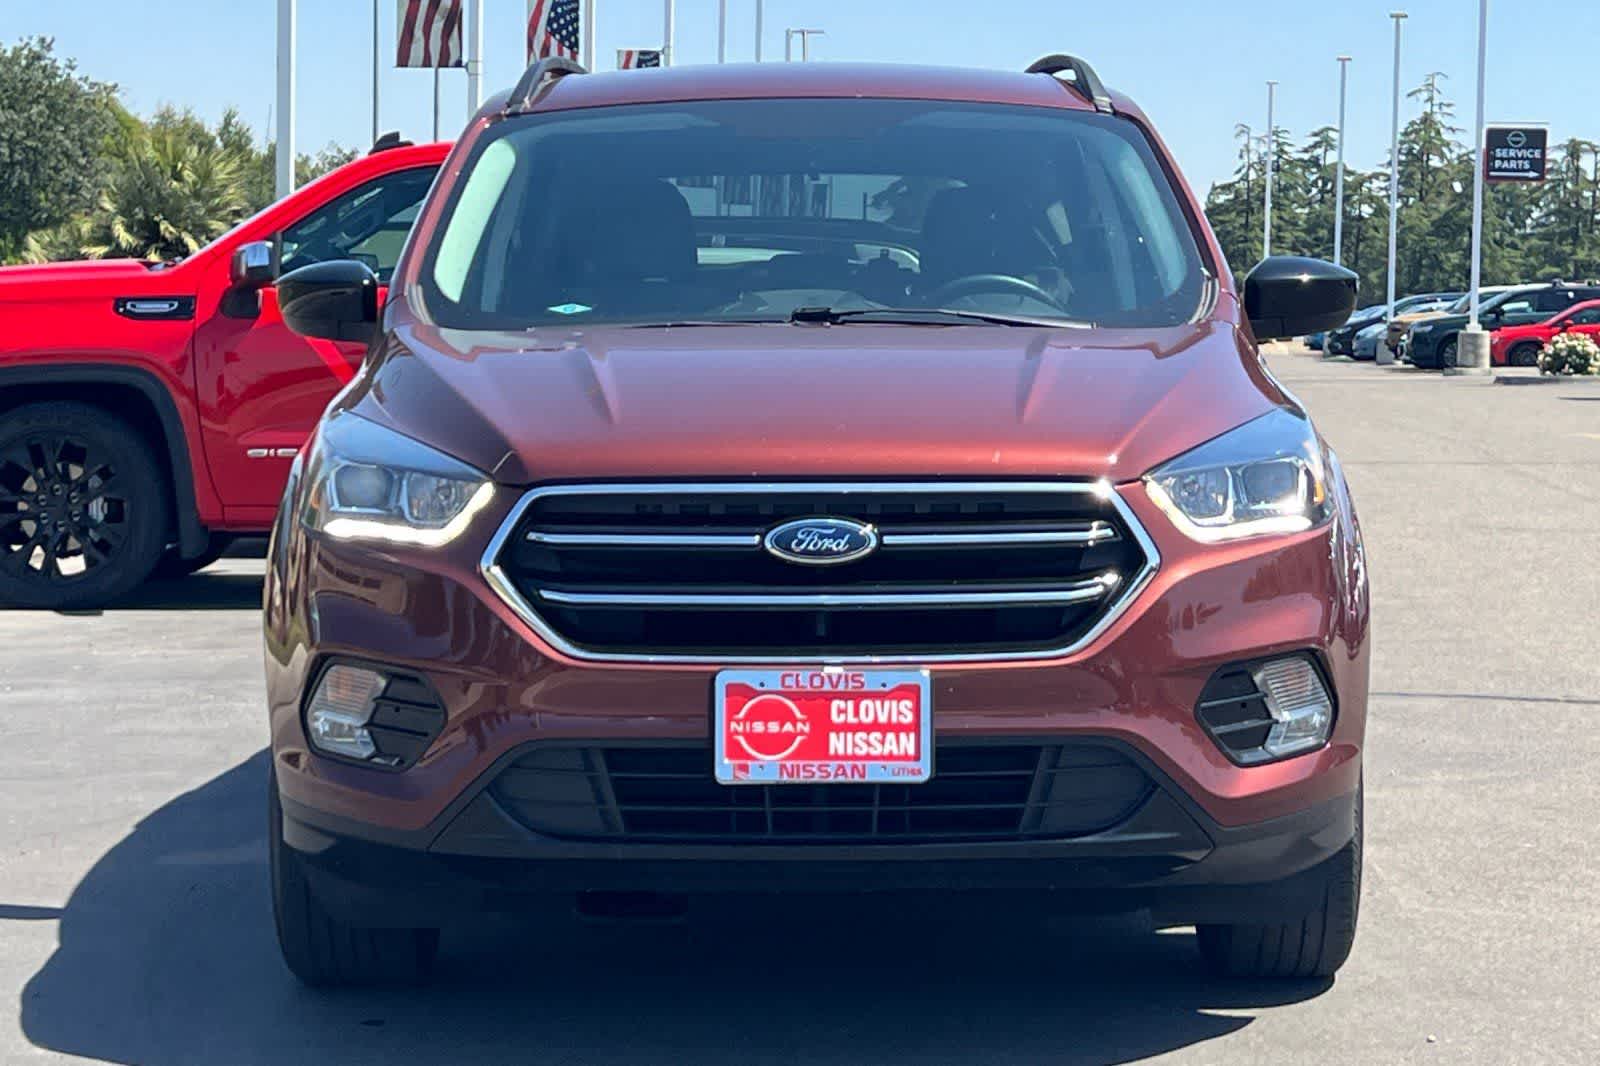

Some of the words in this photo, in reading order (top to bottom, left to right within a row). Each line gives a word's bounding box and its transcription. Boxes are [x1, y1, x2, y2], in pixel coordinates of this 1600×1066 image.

[1495, 148, 1541, 158] SERVICE
[1494, 160, 1530, 169] PARTS
[791, 527, 851, 552] Ford
[780, 672, 865, 689] CLOVIS
[830, 699, 913, 724] CLOVIS
[730, 721, 810, 733] NISSAN
[828, 732, 915, 756] NISSAN
[779, 764, 867, 779] NISSAN
